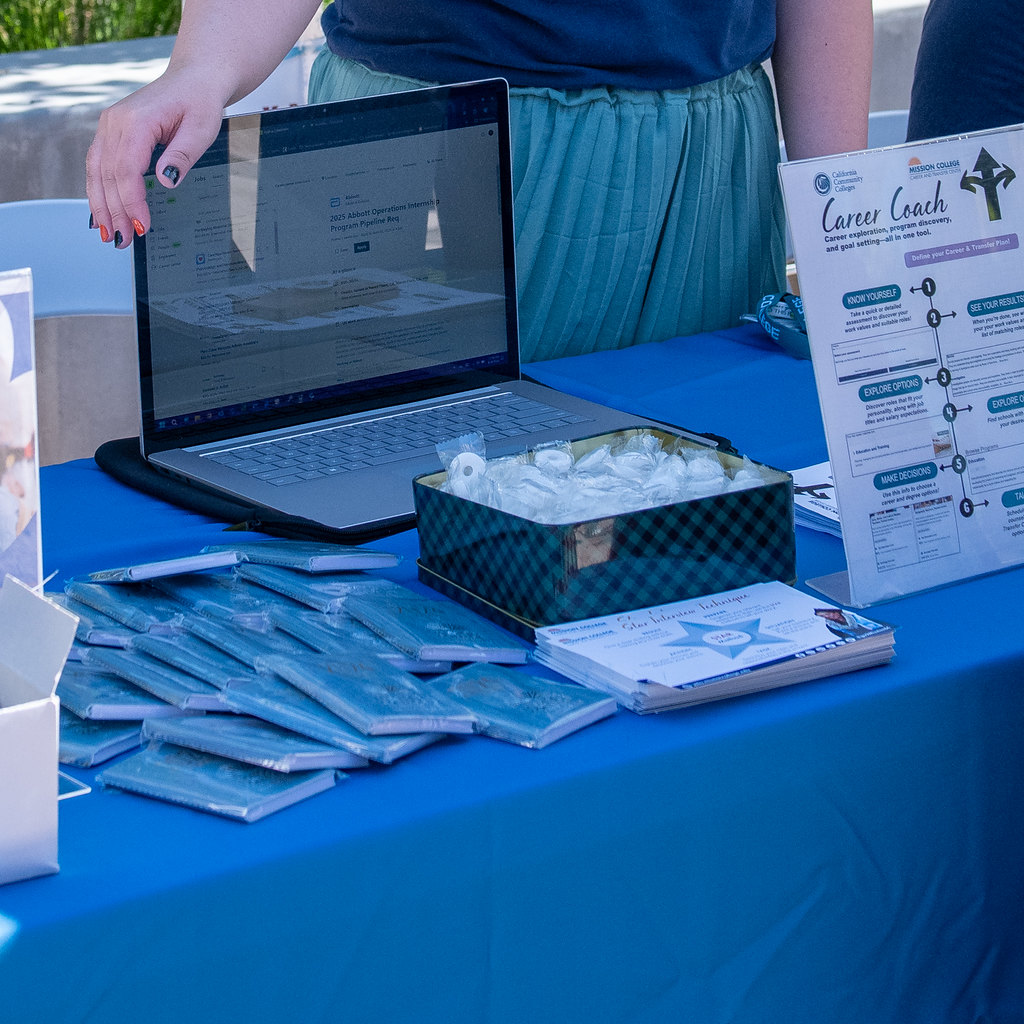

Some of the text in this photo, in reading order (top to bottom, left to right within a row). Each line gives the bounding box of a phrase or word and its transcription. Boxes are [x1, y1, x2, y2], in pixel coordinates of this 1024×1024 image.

[909, 160, 960, 173] MISSION COLLEGE
[832, 170, 857, 178] California
[833, 176, 863, 186] Community
[835, 185, 855, 193] Colleges
[822, 180, 948, 232] Career Coach
[330, 214, 346, 222] 2025
[347, 211, 371, 219] Abbott
[371, 205, 407, 216] Operations
[330, 223, 359, 233] Program
[360, 219, 386, 228] Pipeline
[824, 216, 952, 243] Career exploration, program discovery,
[826, 245, 838, 253] and
[841, 242, 855, 252] goal
[895, 233, 901, 241] in
[902, 232, 915, 240] one
[916, 228, 931, 238] tool.
[912, 253, 930, 261] Define
[932, 251, 945, 259] your
[972, 242, 995, 250] Transfer
[926, 281, 931, 292] 1
[847, 289, 897, 305] KNOW YOURSELF
[866, 307, 877, 315] quick
[884, 303, 901, 311] detailed
[970, 304, 982, 313] SEE
[982, 300, 999, 310] YOUR
[846, 316, 872, 326] assessment
[930, 313, 937, 324] 2
[857, 323, 871, 331] values
[994, 327, 1014, 335] matching
[941, 371, 948, 383] 3
[864, 378, 919, 397] EXPLORE OPTIONS
[865, 402, 885, 410] Discover
[886, 399, 897, 407] roles
[894, 404, 907, 412] along
[992, 396, 1020, 409] EXPLORE
[886, 413, 899, 421] salary
[946, 406, 954, 418] 4
[956, 459, 962, 469] 5
[881, 466, 931, 484] MAKE DECISIONS
[963, 502, 970, 513] 6
